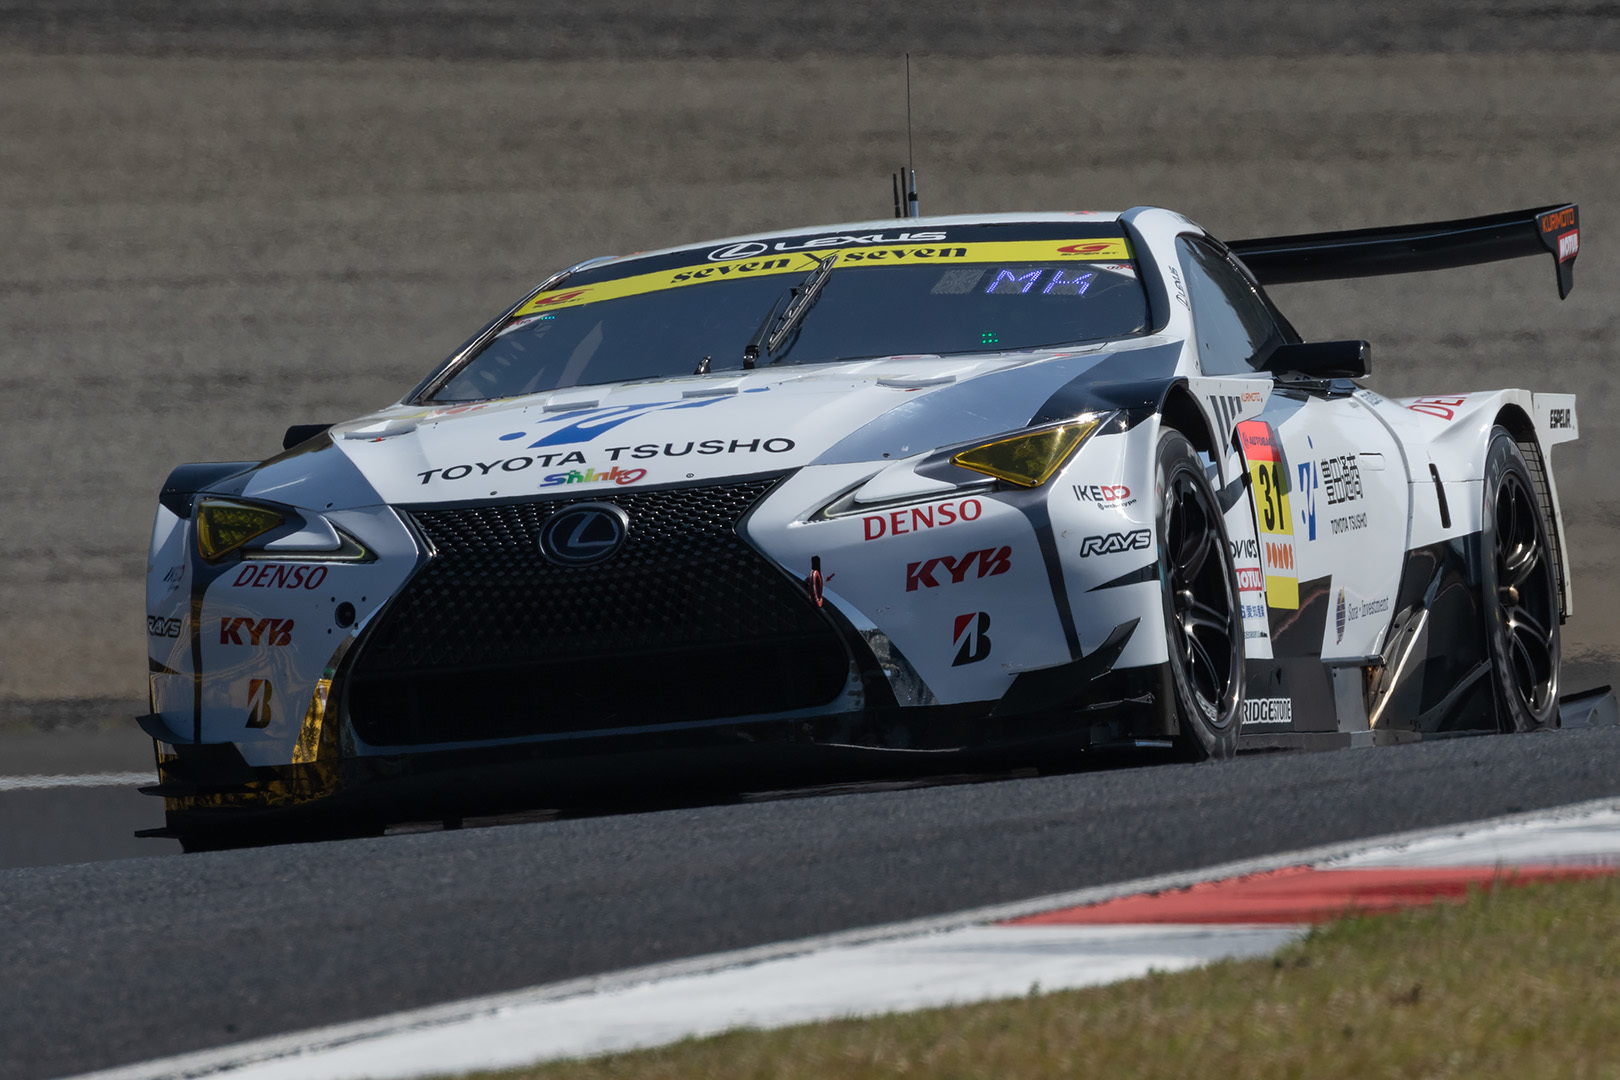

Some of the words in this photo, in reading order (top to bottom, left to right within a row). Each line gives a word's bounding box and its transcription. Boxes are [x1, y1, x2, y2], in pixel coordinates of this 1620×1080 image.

[775, 232, 947, 251] LEXUS
[671, 257, 792, 284] seven
[842, 247, 968, 263] seven
[416, 450, 587, 485] TOYOTA
[603, 437, 796, 462] TSUSHO
[1321, 453, 1363, 505] 豊田通商
[1258, 464, 1285, 532] 31
[862, 498, 983, 541] DENSO
[1080, 529, 1152, 558] RAYS
[1266, 542, 1294, 570] PONOS
[232, 564, 329, 590] DENSO
[905, 545, 1012, 592] KYB
[147, 615, 182, 638] RAYS
[219, 617, 295, 646] KYB
[1243, 700, 1291, 722] RIDGESTONE
